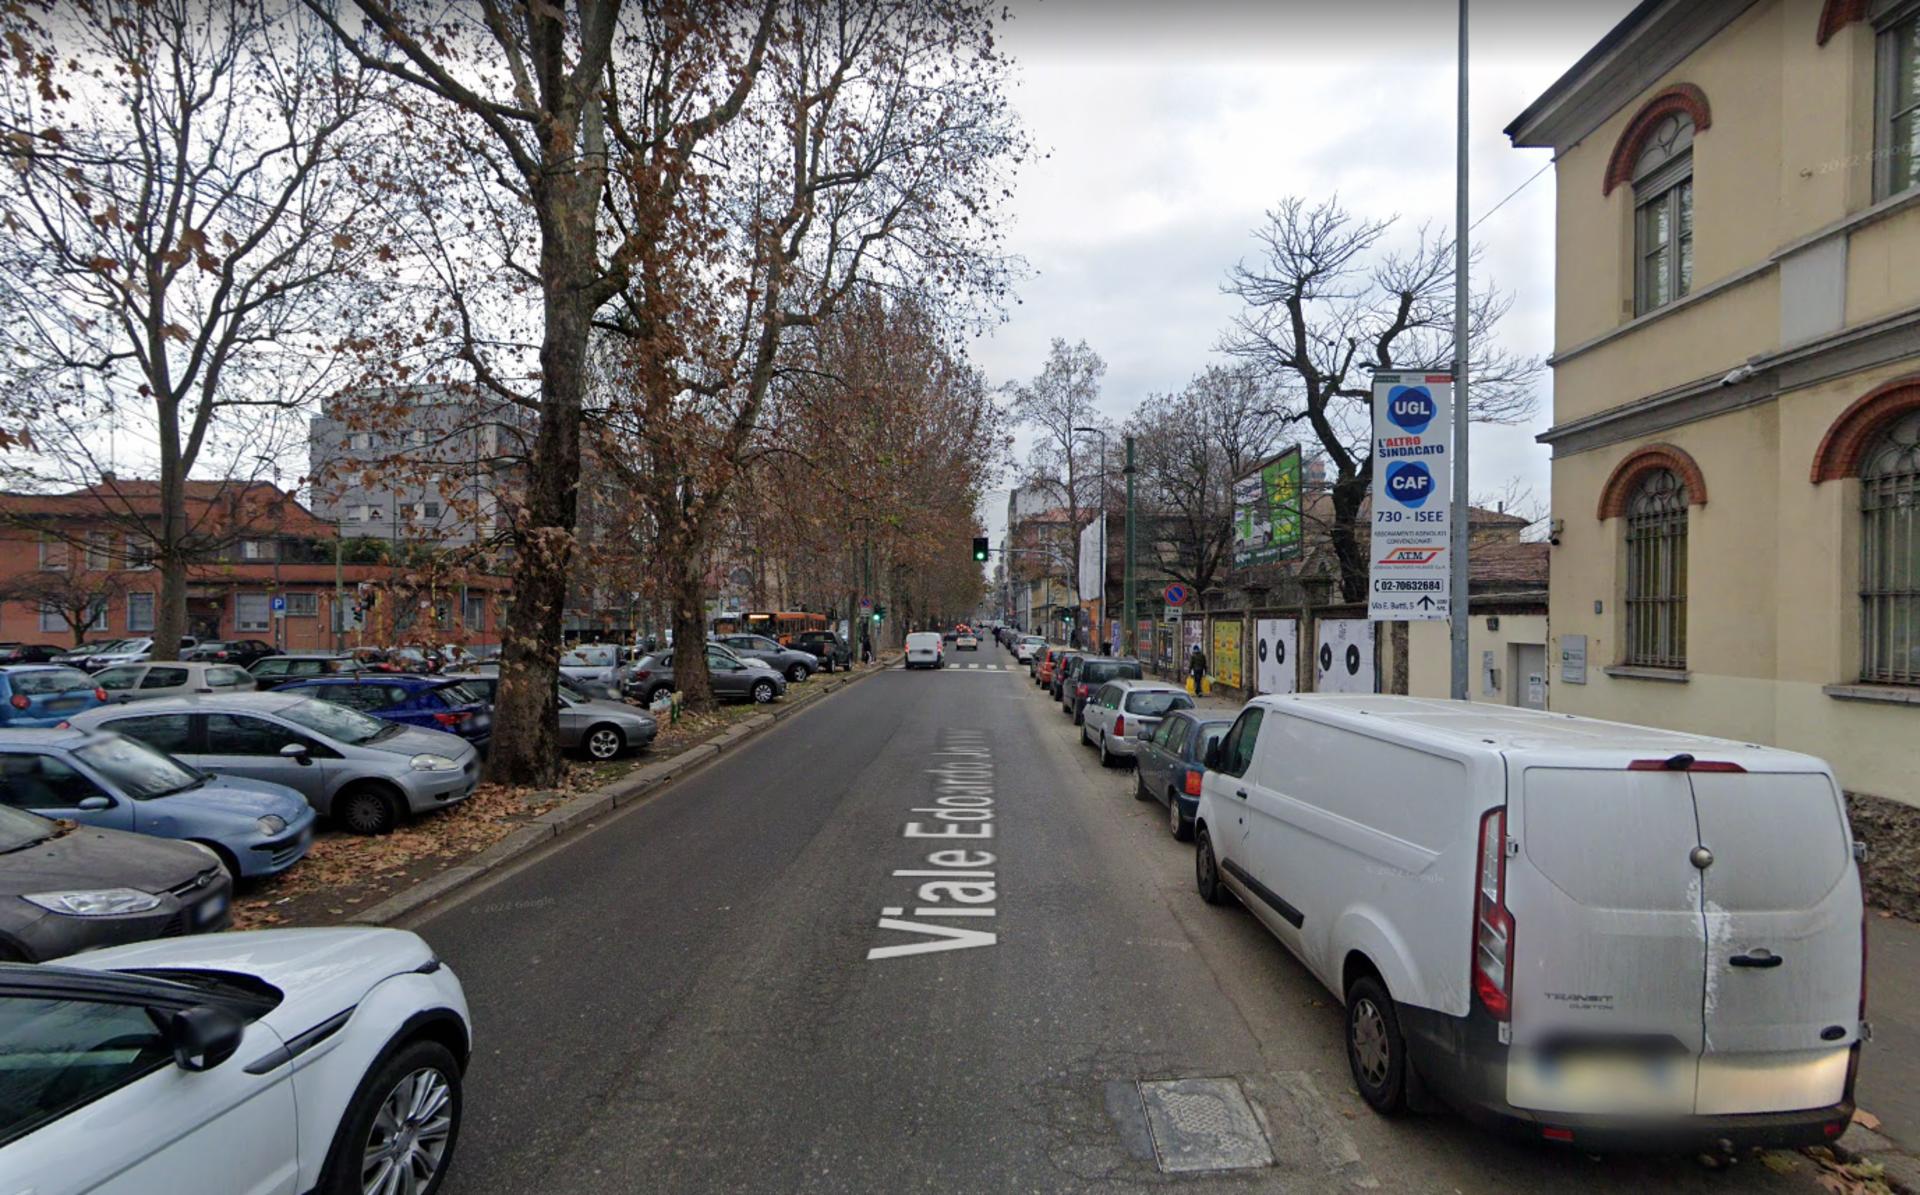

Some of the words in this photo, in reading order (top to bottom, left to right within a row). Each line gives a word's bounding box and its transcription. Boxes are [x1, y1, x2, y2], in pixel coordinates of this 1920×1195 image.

[1395, 401, 1430, 415] UGL
[1378, 436, 1421, 448] L'ALTRO
[1379, 444, 1445, 458] SINDACATO
[1392, 476, 1428, 490] CAF
[1377, 511, 1402, 522] 730
[1415, 511, 1444, 522] ISEE
[1397, 552, 1423, 560] ATM
[1381, 581, 1440, 590] 02-70632684
[274, 598, 283, 609] P
[1544, 992, 1613, 1002] TRANSIT
